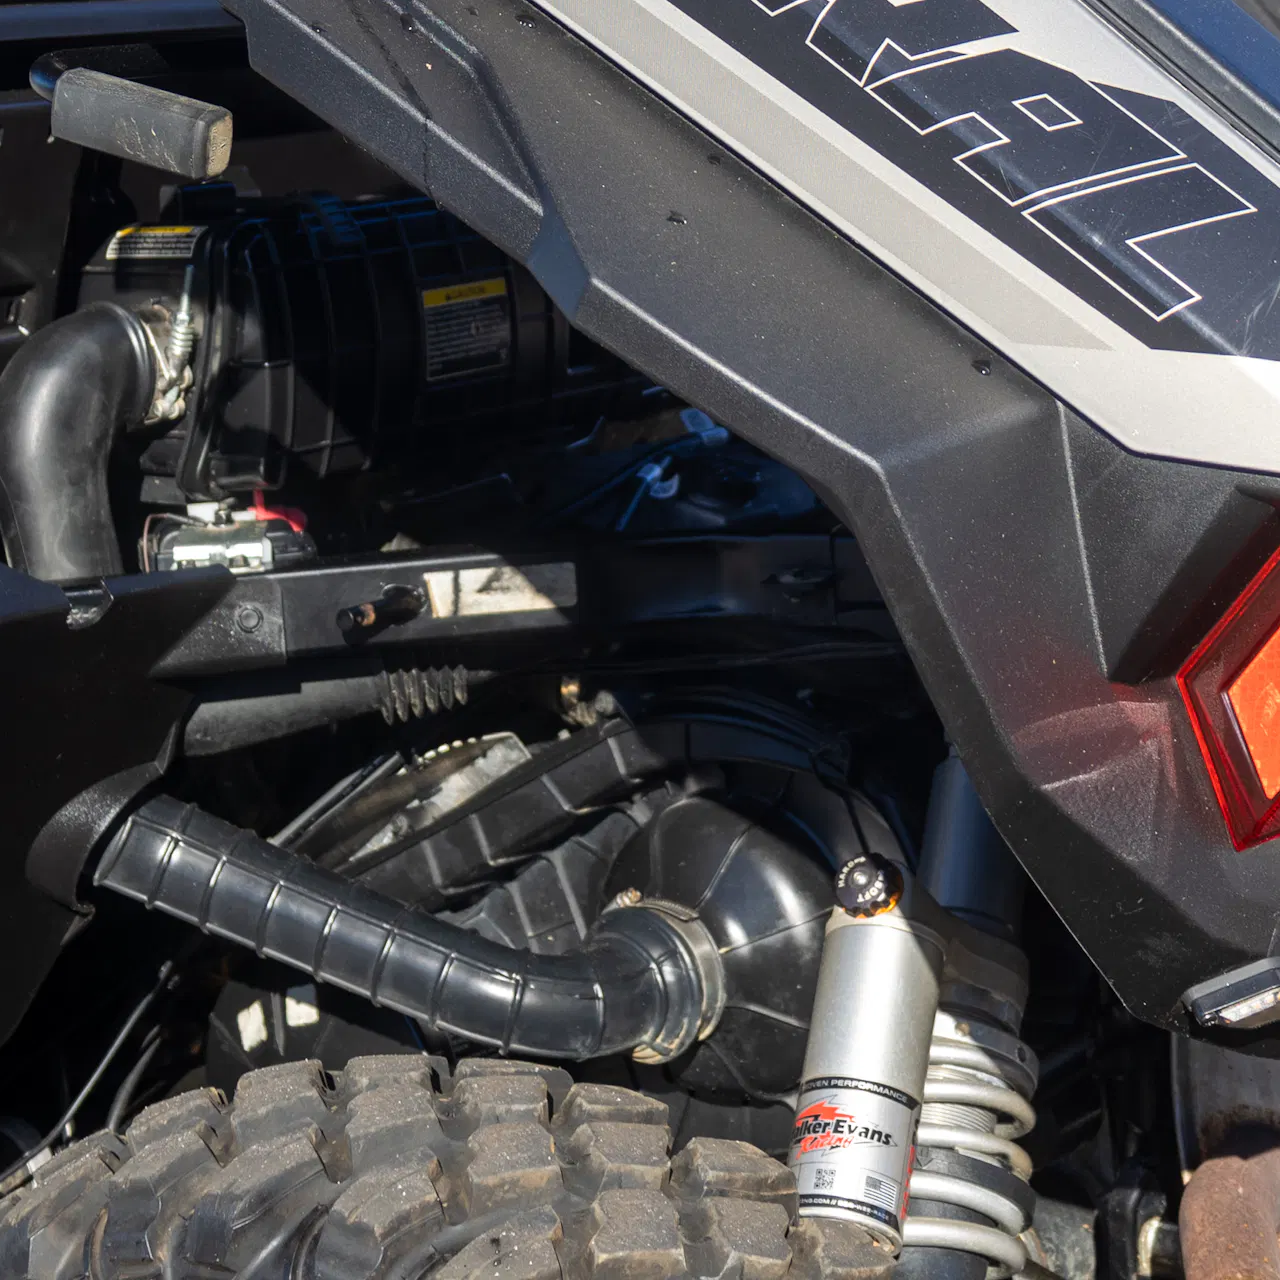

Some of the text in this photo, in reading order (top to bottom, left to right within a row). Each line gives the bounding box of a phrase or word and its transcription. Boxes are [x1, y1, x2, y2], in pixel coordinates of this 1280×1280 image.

[804, 1079, 908, 1103] OVEN PERFORMANCE
[793, 1119, 892, 1146] alker Evans
[796, 1132, 855, 1160] Racing
